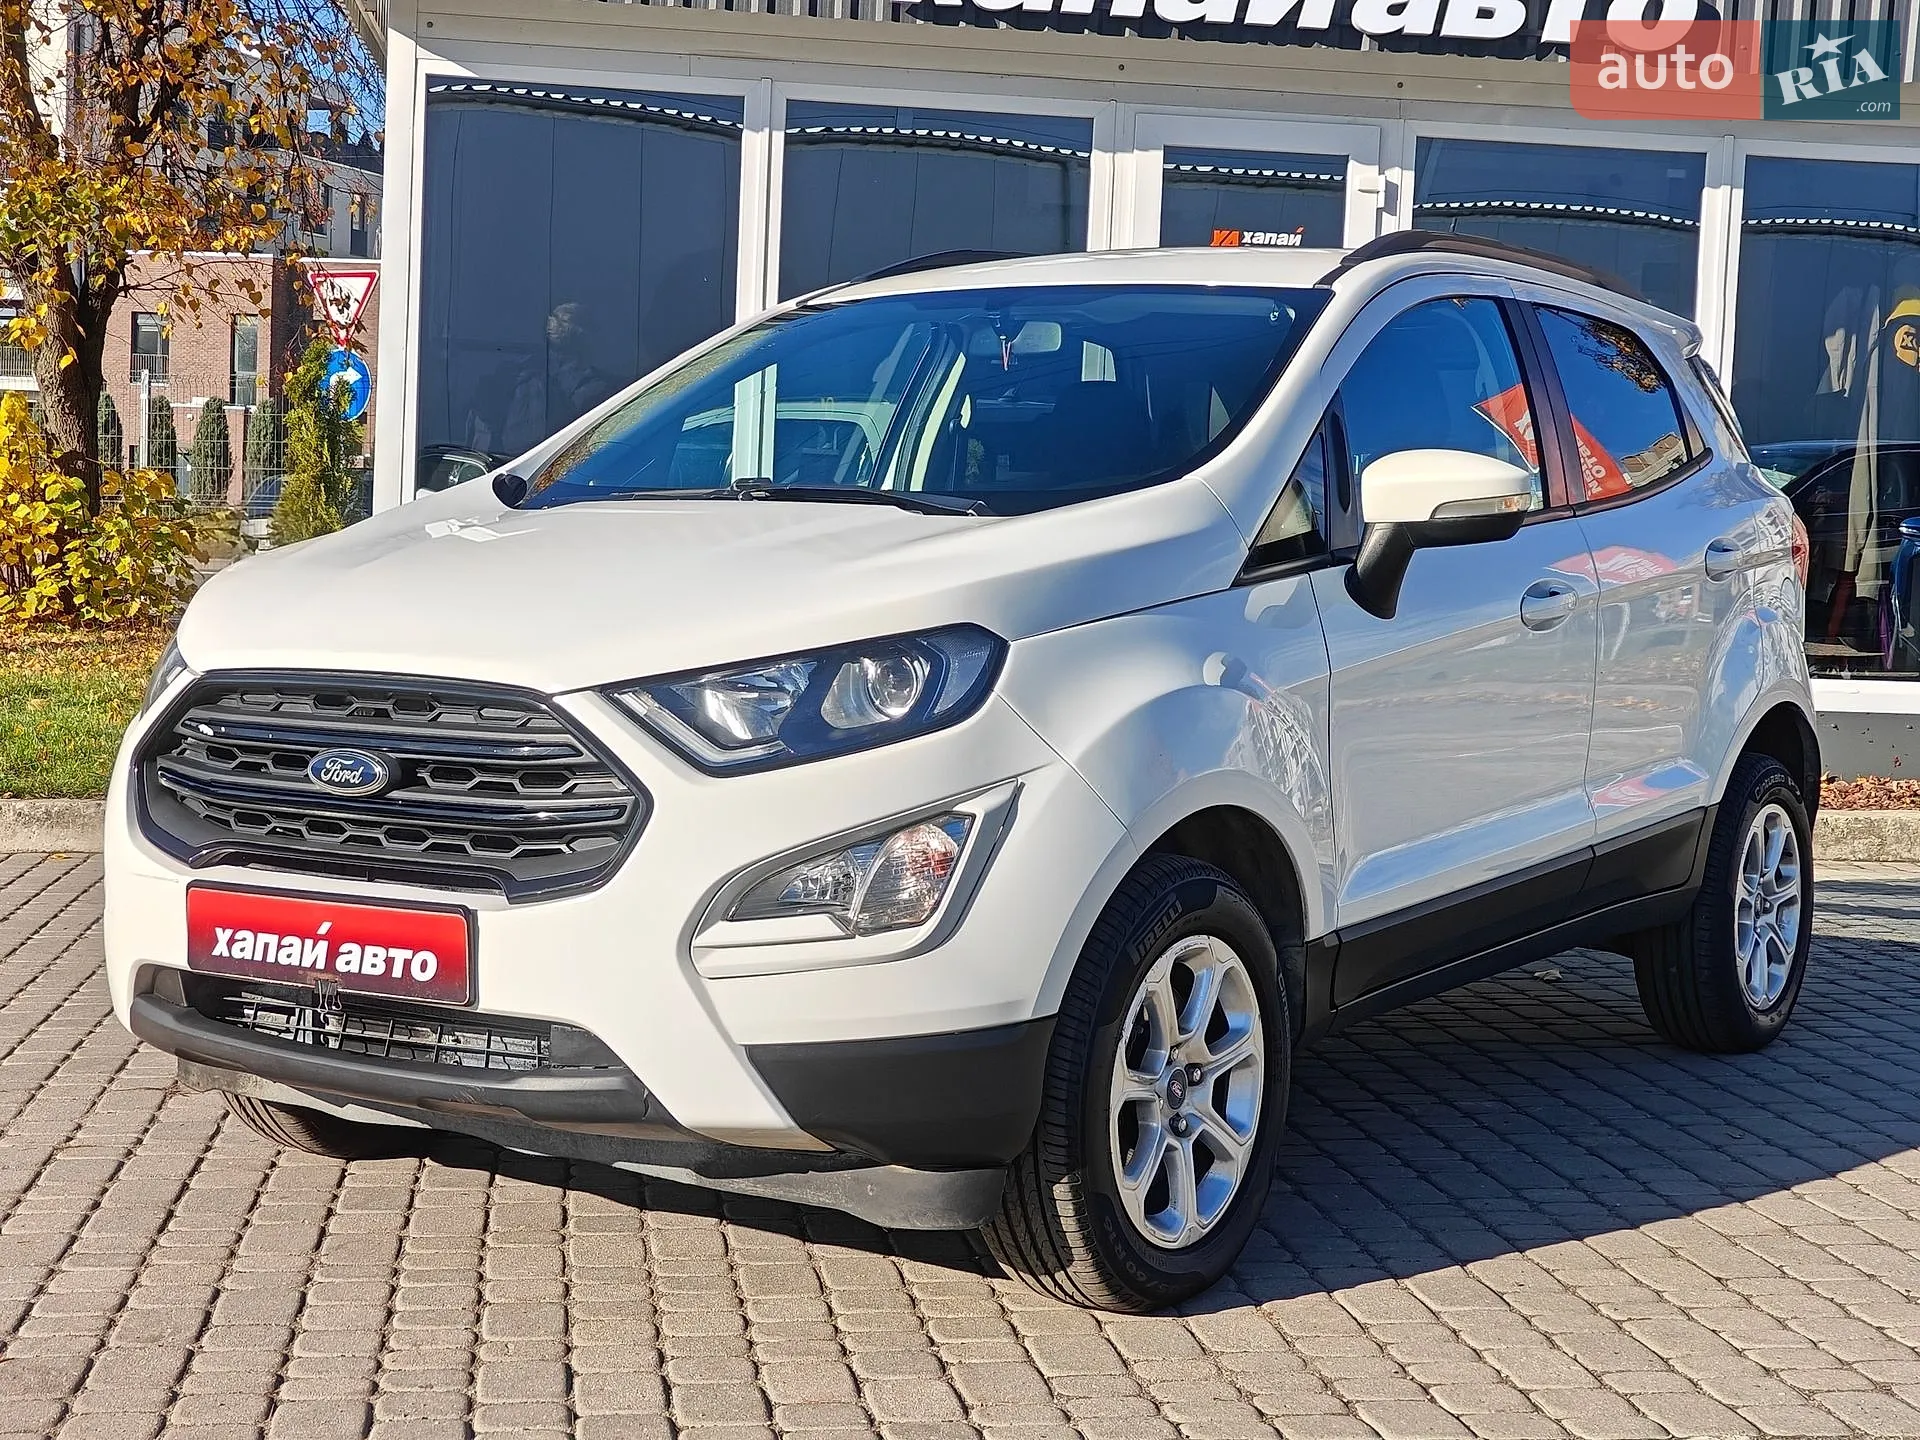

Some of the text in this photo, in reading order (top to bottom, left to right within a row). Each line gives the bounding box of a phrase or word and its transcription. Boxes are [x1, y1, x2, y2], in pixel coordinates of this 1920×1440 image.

[320, 757, 364, 784] Ford
[211, 921, 438, 982] хапай авто
